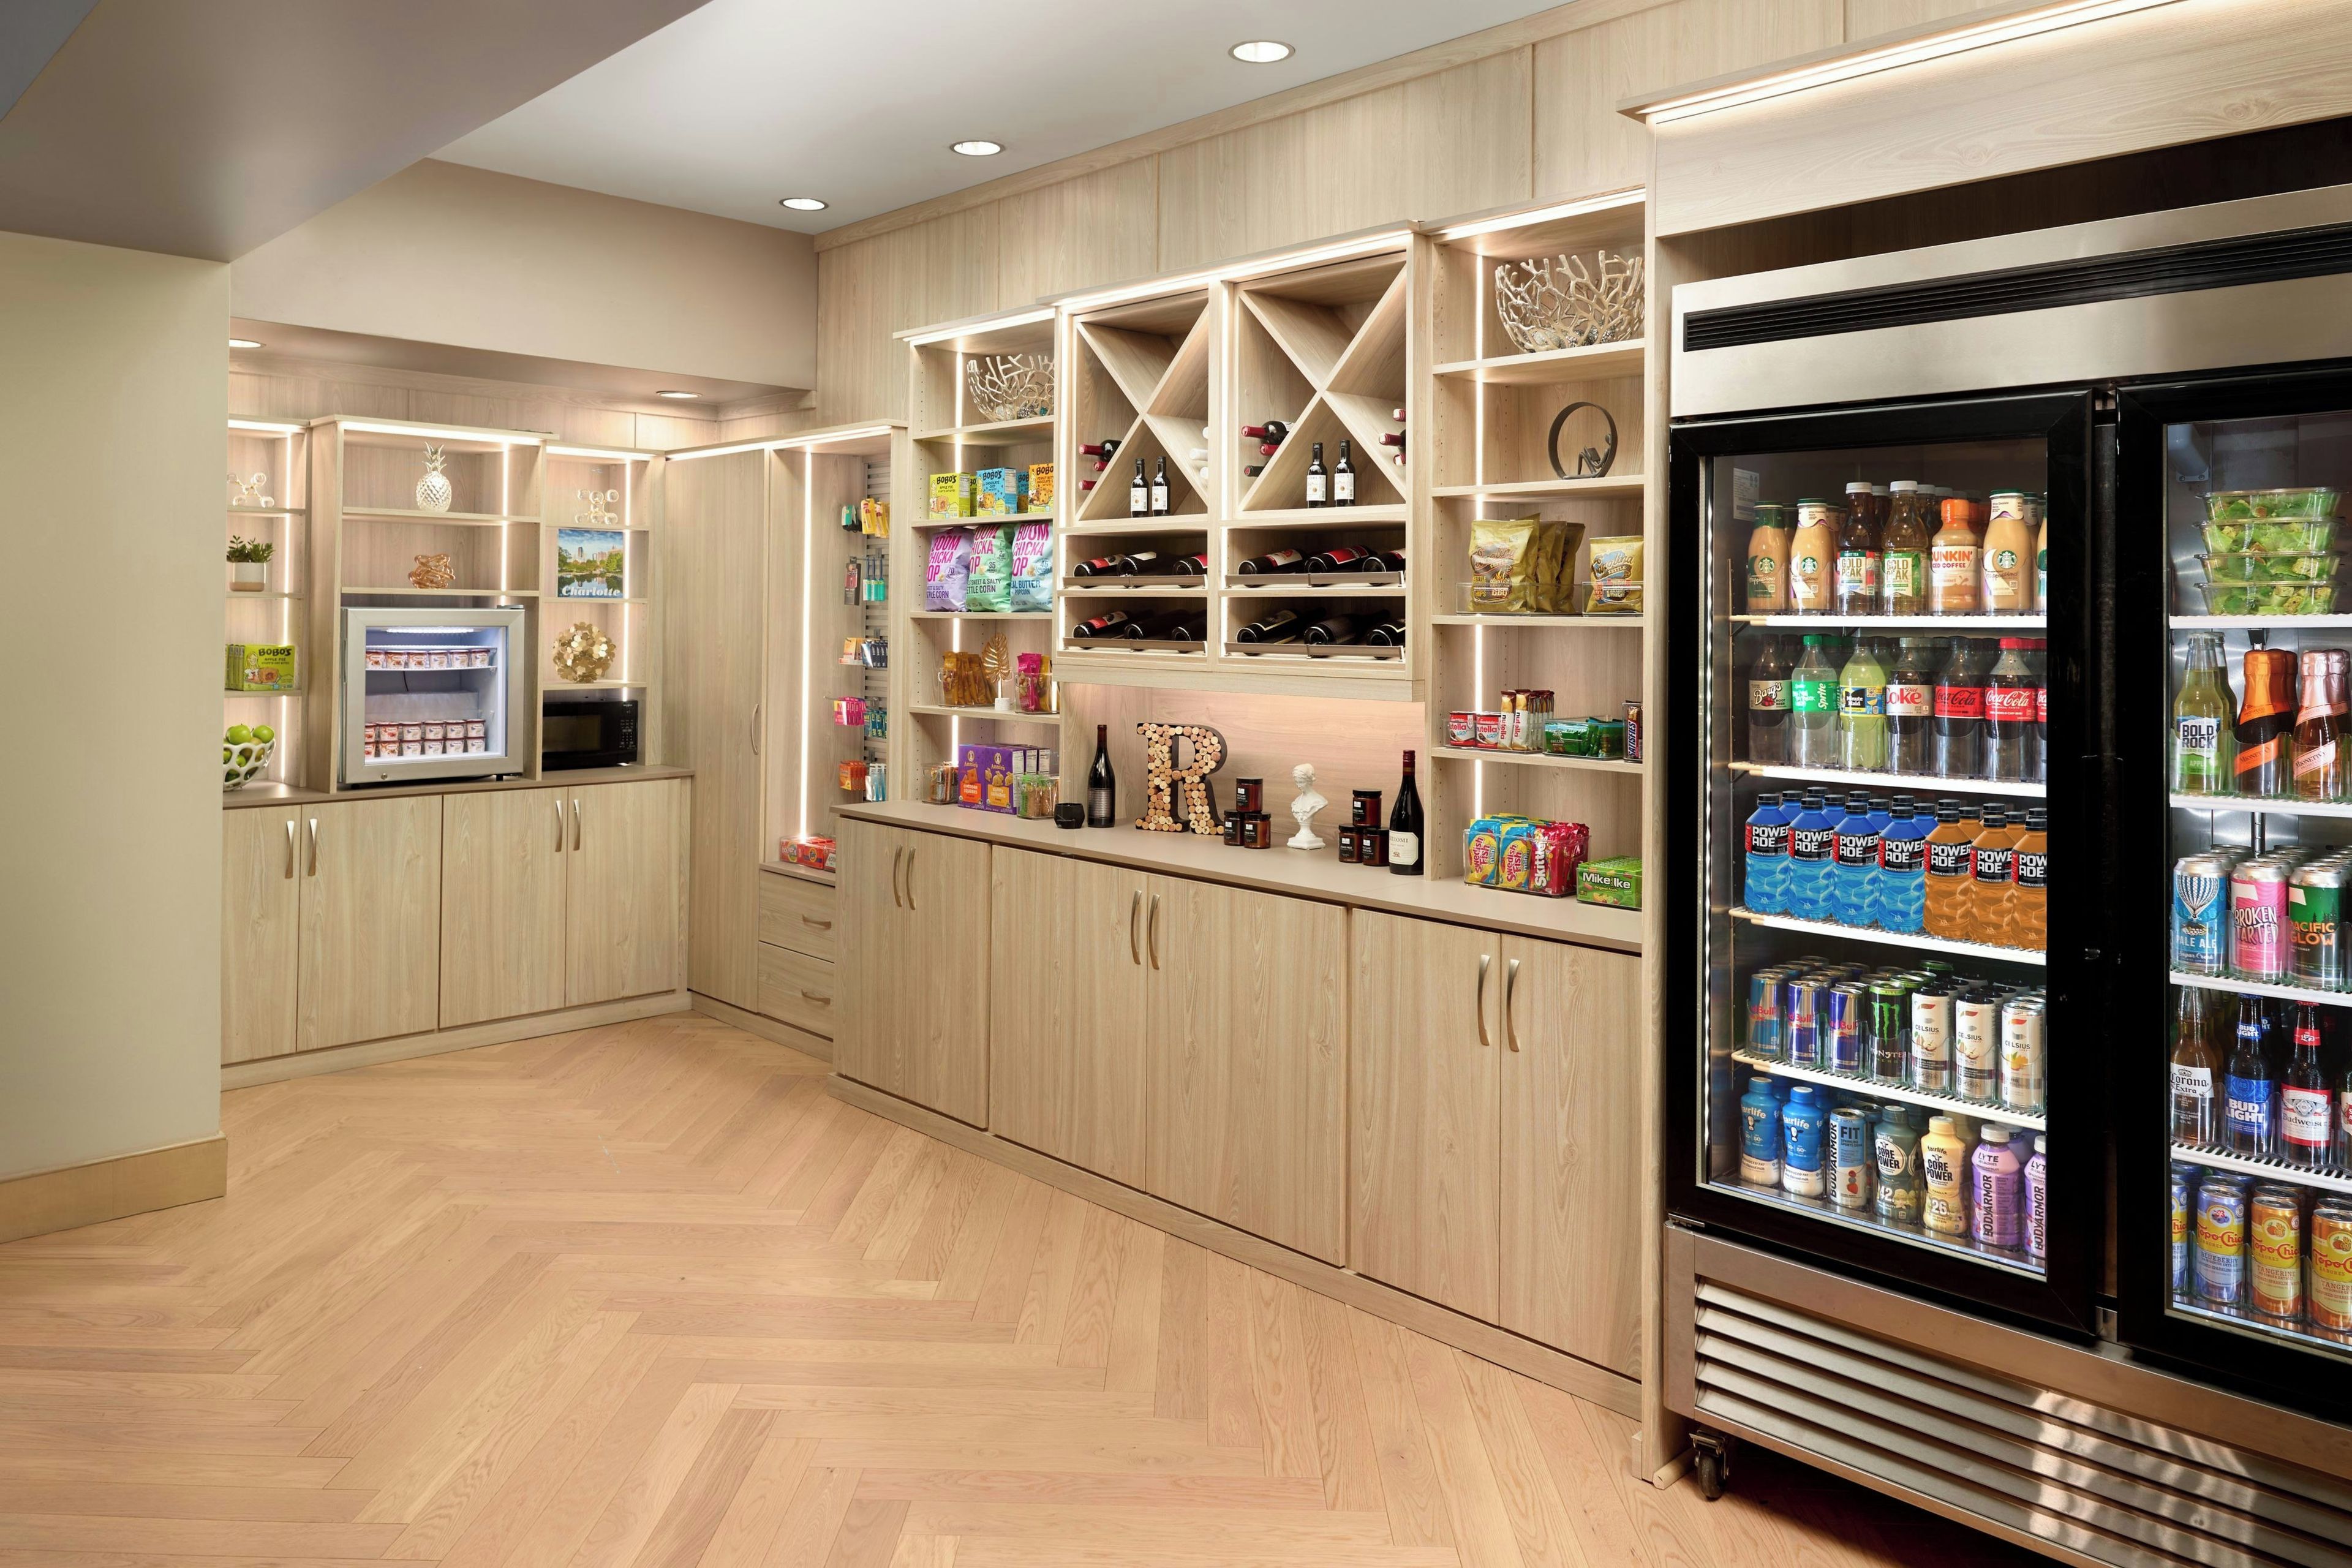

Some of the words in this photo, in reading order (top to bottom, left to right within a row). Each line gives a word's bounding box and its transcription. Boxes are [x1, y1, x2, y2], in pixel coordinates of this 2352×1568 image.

[983, 470, 1002, 480] BOBO'S
[1036, 466, 1054, 475] BOBO
[937, 475, 957, 484] BOBO'S
[1017, 523, 1050, 541] BOOM
[970, 556, 981, 575] OP
[1012, 557, 1028, 577] OP
[1607, 565, 1627, 575] KETTLE
[927, 565, 940, 582] OP
[562, 586, 620, 596] Charlotte
[1018, 580, 1041, 589] BUTTER
[258, 648, 292, 657] BOBO'S
[1754, 681, 1783, 705] Barq's
[1817, 683, 1827, 710] Sprite
[1887, 687, 1922, 705] Coke
[1936, 688, 1978, 706] Coca-Cola
[1986, 690, 2032, 707] Coca-Cola
[2182, 725, 2214, 737] BOLD
[1627, 721, 1637, 758] SATISFIES
[2182, 736, 2215, 748] ROCK
[1135, 722, 1227, 835] R
[1752, 837, 1776, 848] ADE
[1795, 841, 1819, 853] ADE
[1839, 835, 1879, 847] POWER
[1473, 837, 1485, 873] Swedish
[1479, 845, 1490, 867] Fish
[1839, 846, 1863, 858] ADE
[1885, 851, 1910, 864] ADE
[1977, 850, 2012, 862] POWE
[1507, 844, 1517, 882] Swedish
[1513, 851, 1522, 873] Fish
[1534, 836, 1548, 888] Skittles
[1931, 856, 1955, 867] ADE
[1977, 861, 2002, 873] ADE
[2019, 854, 2046, 867] POW
[2019, 865, 2045, 878] ADE
[1583, 872, 1611, 885] Mike
[1613, 878, 1630, 889] Ike
[2234, 906, 2278, 926] BROKEN
[2199, 938, 2217, 949] ALE
[2291, 931, 2335, 946] GLOW
[1757, 1006, 1774, 1016] Bull
[1795, 1013, 1813, 1023] Bull
[1840, 1021, 1858, 1031] Bull
[1915, 1024, 1940, 1033] CELSIUS
[1958, 1031, 1982, 1041] CESIUS
[2170, 1073, 2209, 1087] Corona
[2176, 1084, 2197, 1094] Extra
[2229, 1098, 2260, 1113] BUD
[2225, 1106, 2266, 1123] LIGHT
[2283, 1114, 2328, 1128] Budweise
[1841, 1126, 1860, 1139] FIT
[1877, 1146, 1895, 1159] CORE
[1928, 1145, 1948, 1155] fairlife
[1877, 1154, 1900, 1169] POWER
[1978, 1152, 1999, 1163] LYTE
[1928, 1159, 1948, 1172] CORE
[2031, 1160, 2046, 1172] LYT
[1926, 1167, 1953, 1182] POWER
[1983, 1175, 1993, 1237] BODYARMOR
[2034, 1186, 2045, 1251] BODYARMOR
[2197, 1221, 2220, 1240] Topo
[2220, 1231, 2244, 1247] Chic
[2252, 1234, 2277, 1253] Topo
[2201, 1251, 2239, 1265] BLUEBERRY
[2313, 1248, 2342, 1268] Topo
[2257, 1265, 2296, 1277] TANGERINE
[2321, 1280, 2352, 1293] TANGER
